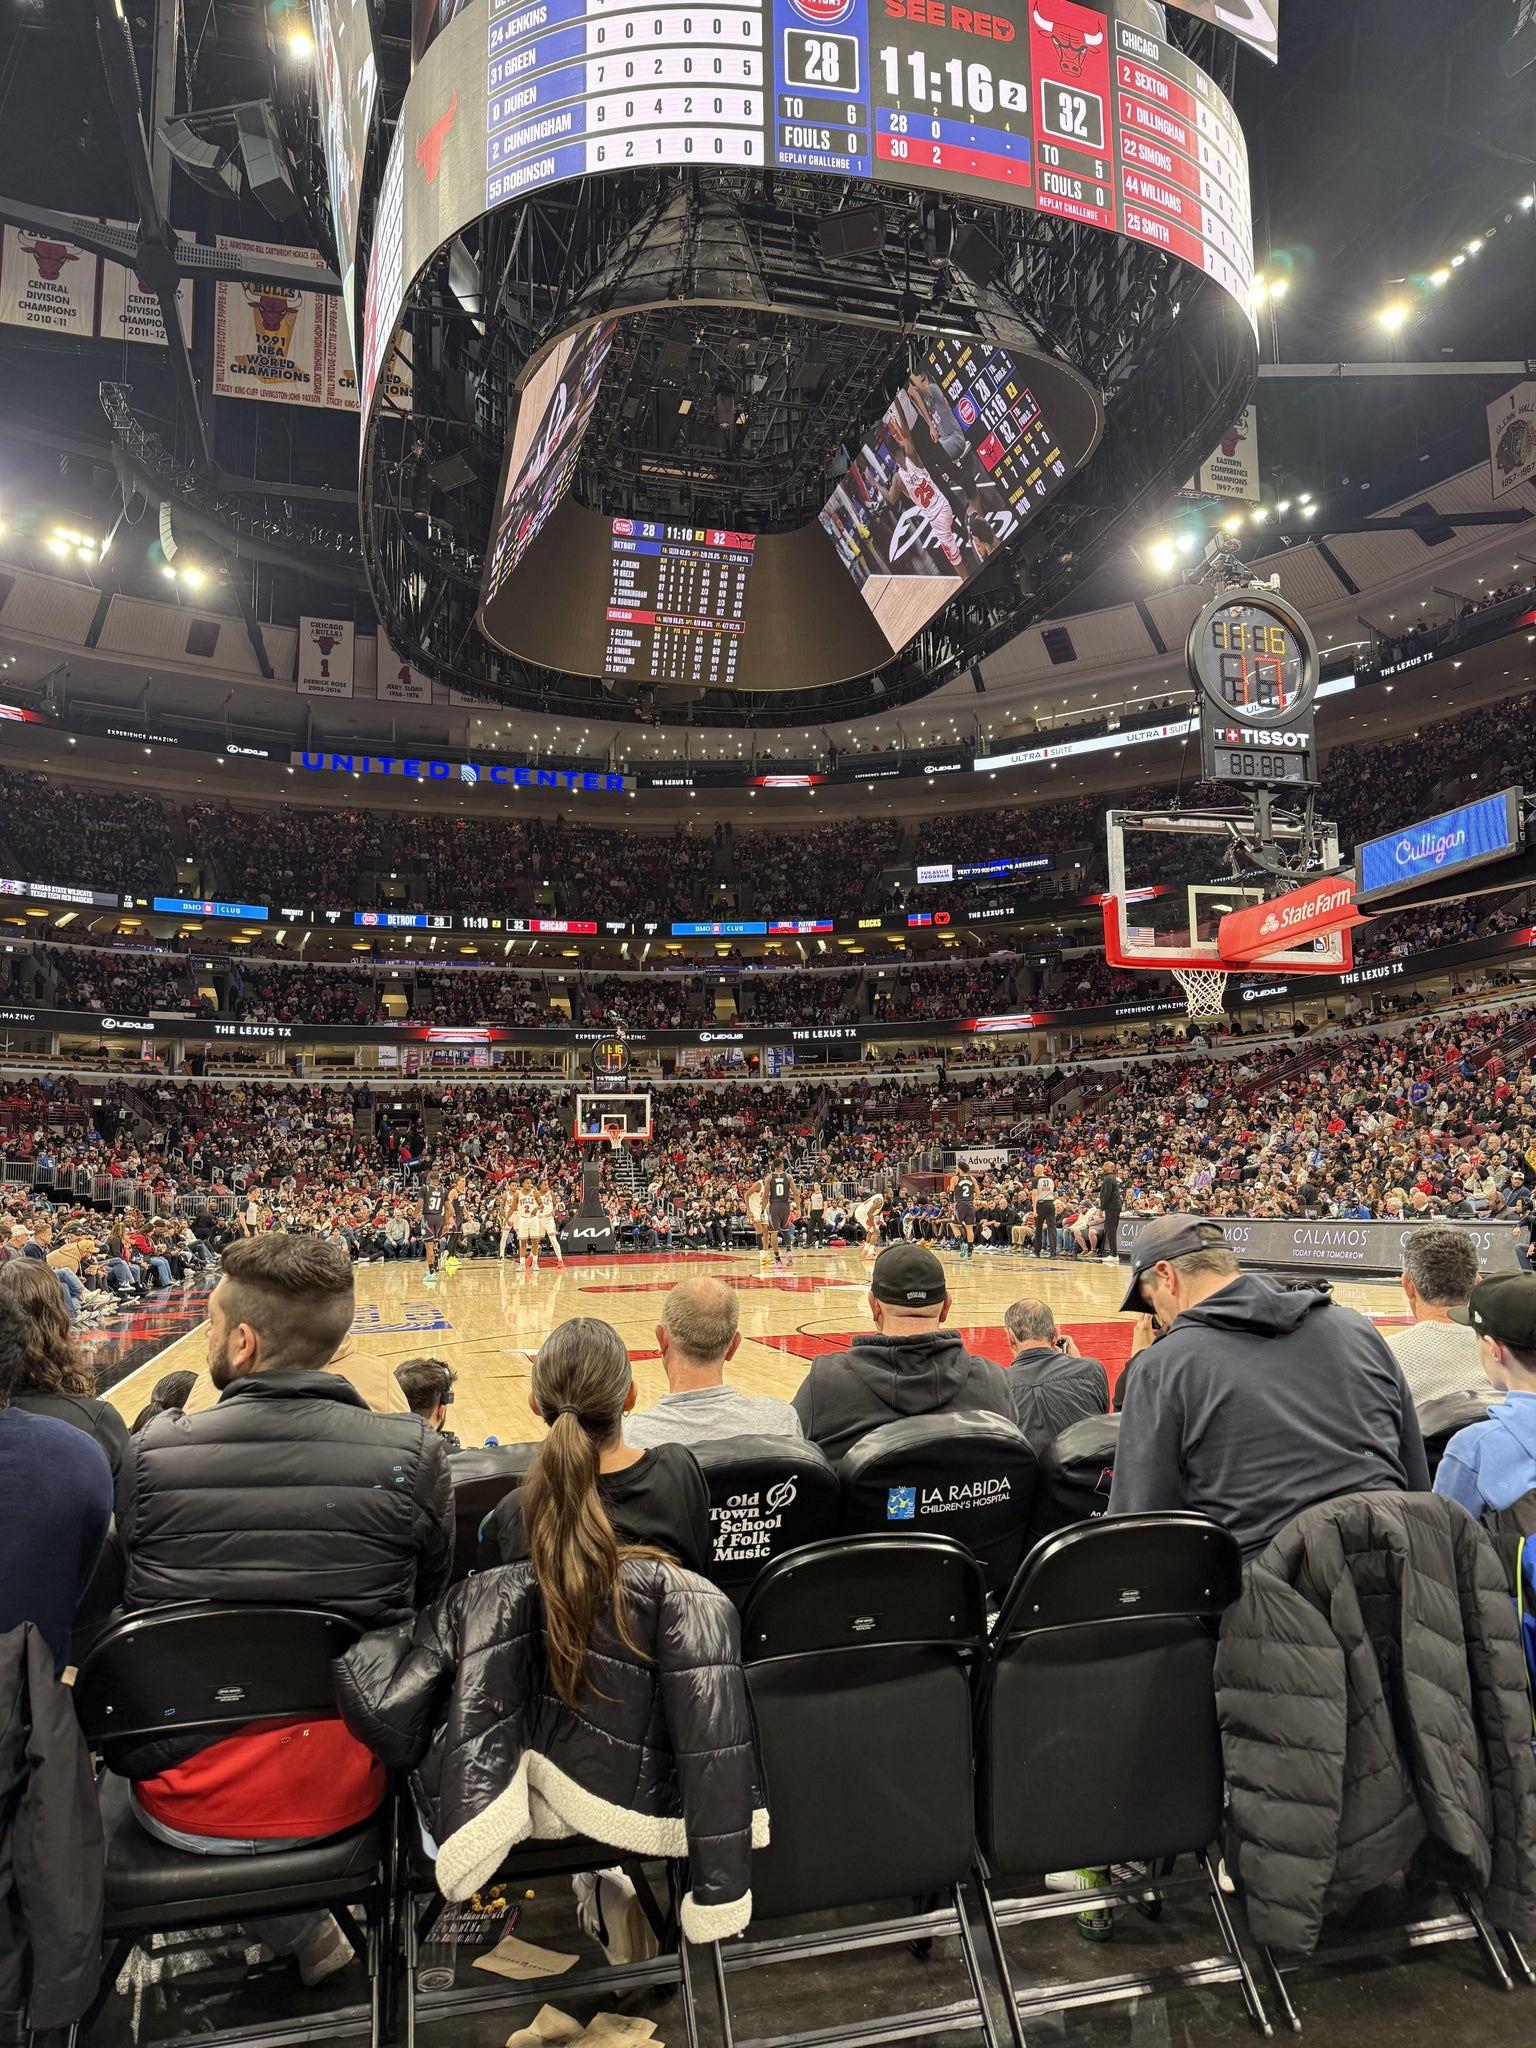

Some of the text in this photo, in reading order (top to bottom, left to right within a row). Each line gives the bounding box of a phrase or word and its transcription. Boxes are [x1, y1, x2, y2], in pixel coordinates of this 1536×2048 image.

[491, 6, 547, 48] 24 JENKINS
[885, 0, 1015, 42] SEE RED
[1122, 30, 1159, 61] CHICAGO
[491, 48, 536, 85] 31 GREEN
[805, 39, 840, 82] 28
[880, 45, 994, 113] 11:16
[1135, 71, 1168, 100] SEXTON
[504, 85, 537, 115] DUREN
[784, 97, 857, 125] TO 6
[1059, 92, 1088, 138] 32
[890, 113, 908, 133] 28
[1137, 107, 1185, 146] DILLINGHAM
[504, 113, 571, 154] CUNNINGHAM
[785, 126, 830, 150] FOULS
[890, 138, 908, 158] 30
[1043, 144, 1059, 166] TO
[1124, 139, 1172, 172] 22 SIMONS
[779, 151, 850, 170] REPLAY CHALLENGE
[489, 157, 555, 200] 55 ROBINSON
[1044, 172, 1082, 200] FOULS
[1126, 176, 1181, 213] 44 WILLIAMS
[1040, 196, 1098, 221] REPLAY CHALLENGE
[1127, 213, 1169, 243] 25 SMITH
[28, 279, 69, 294] CENTRAL
[255, 284, 295, 298] BULLS
[26, 291, 70, 305] DIVISION
[18, 301, 77, 316] CHAMPIONS
[127, 306, 161, 317] DIVISIO
[256, 333, 286, 346] 1991
[257, 345, 285, 357] NBA
[247, 354, 295, 369] WORLD
[230, 363, 311, 383] CHAMPIONS
[1509, 394, 1515, 409] 1
[1519, 403, 1535, 414] HALL
[980, 393, 1008, 431] 11:16
[1216, 457, 1241, 467] EASTERN
[1211, 465, 1248, 477] CONFERENCE
[1502, 461, 1535, 488] 1957-1967
[1211, 474, 1247, 485] CHAMPIONS
[643, 524, 693, 541] 28 11:16
[614, 541, 636, 551] DETROIT
[310, 621, 344, 630] CHICAGO
[315, 629, 339, 637] BULLS
[1221, 622, 1285, 655] 11:16
[320, 659, 330, 678] 1
[1381, 652, 1433, 677] THE LEXUS TX
[304, 678, 329, 686] DERRICK
[398, 666, 411, 684] 4
[1240, 655, 1283, 710] 17
[107, 729, 178, 743] EXPERIENCE AMAZING
[1127, 730, 1159, 742] ULTRA
[1240, 730, 1309, 748] TISSOT
[239, 748, 268, 757] LEXUS
[1011, 746, 1073, 763] ULTRA SUITE
[302, 751, 625, 793] UNITED CENTER
[1395, 829, 1466, 865] Culligan
[1014, 859, 1048, 869] ASSISTANCE
[48, 892, 60, 900] TECH
[72, 895, 93, 904] RAIDERS
[67, 888, 92, 897] WILDCATS
[183, 903, 201, 911] BMO
[968, 907, 1015, 920] THE LEXUS TX
[388, 915, 417, 926] DETROIT
[540, 920, 568, 931] CHICAGO
[859, 919, 881, 928] BLOCKS
[1339, 963, 1404, 985] THE LEXUS TX
[1255, 986, 1288, 997] LEXUS
[1116, 1001, 1189, 1016] EXPERIENCE AMAZING
[116, 1021, 154, 1030] LEXUS
[216, 1024, 292, 1036] THE LEXUS TX
[793, 1028, 857, 1039] THE LEXUS TX
[968, 1156, 1005, 1165] Advocate
[776, 1184, 784, 1196] 0
[963, 1186, 969, 1197] 2
[429, 1197, 441, 1211] 31
[524, 1205, 530, 1213] 2
[1294, 1229, 1368, 1246] CALAMOS
[1292, 1249, 1311, 1257] TODAY
[1327, 1251, 1363, 1259] TOMORROW
[920, 1476, 1011, 1504] LA RABIDA
[726, 1492, 759, 1508] Old
[973, 1492, 1010, 1509] HOSPITAL
[709, 1507, 760, 1522] Town
[720, 1514, 782, 1534] School
[730, 1531, 771, 1547] Folk
[713, 1545, 771, 1562] Music
